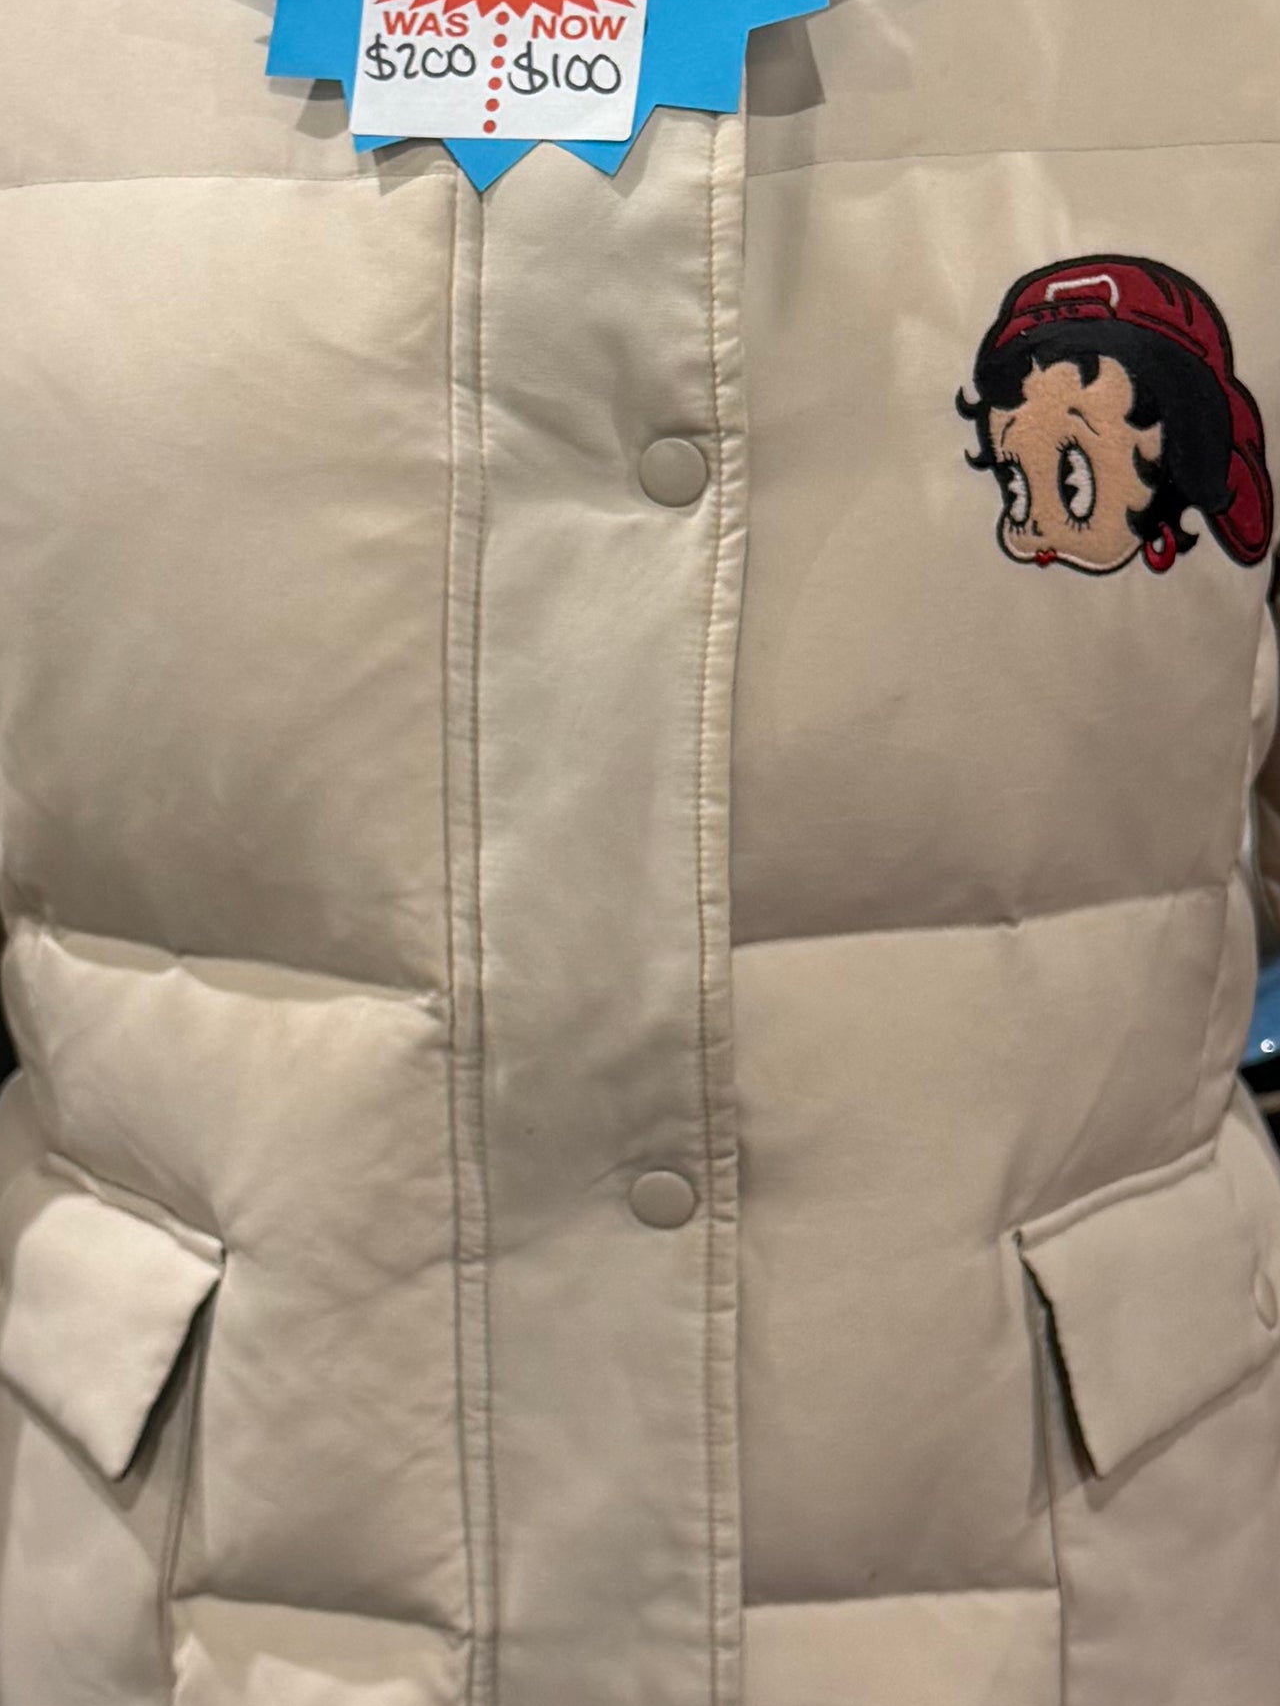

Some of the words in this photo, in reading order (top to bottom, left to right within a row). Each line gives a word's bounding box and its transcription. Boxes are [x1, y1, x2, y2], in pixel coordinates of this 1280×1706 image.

[383, 11, 469, 38] WAS
[531, 14, 626, 41] NOW
[364, 33, 476, 81] $200
[507, 40, 622, 95] $100
